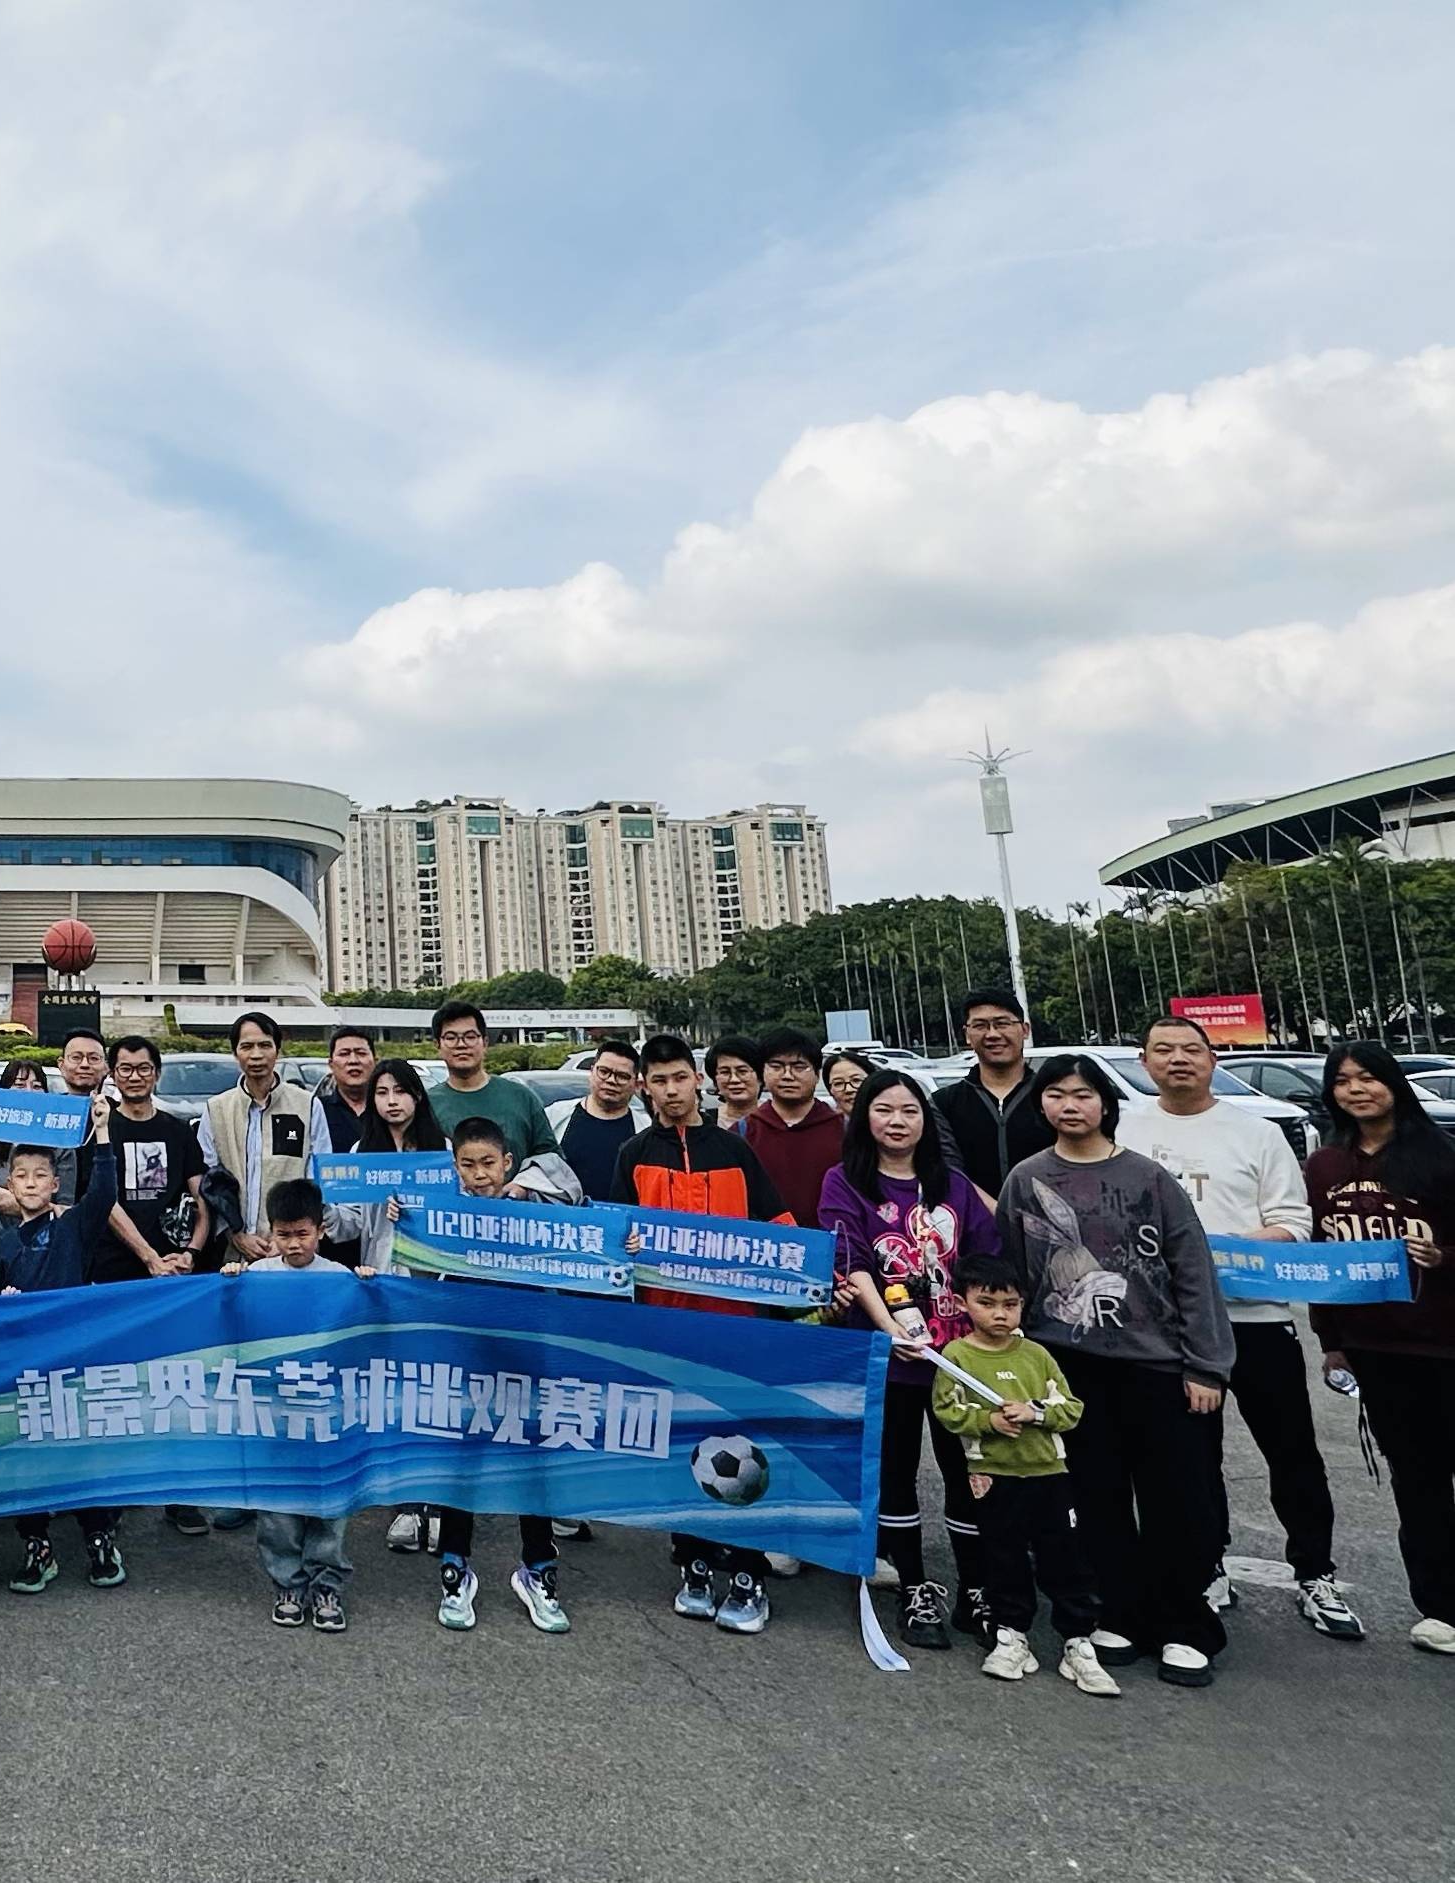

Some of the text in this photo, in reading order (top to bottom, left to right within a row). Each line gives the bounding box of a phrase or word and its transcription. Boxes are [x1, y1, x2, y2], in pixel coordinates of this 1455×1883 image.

[427, 1209, 603, 1254] U20亚洲杯决赛
[1137, 1225, 1159, 1257] S
[1274, 1262, 1400, 1281] 好旅游·新景界
[1094, 1297, 1123, 1328] R
